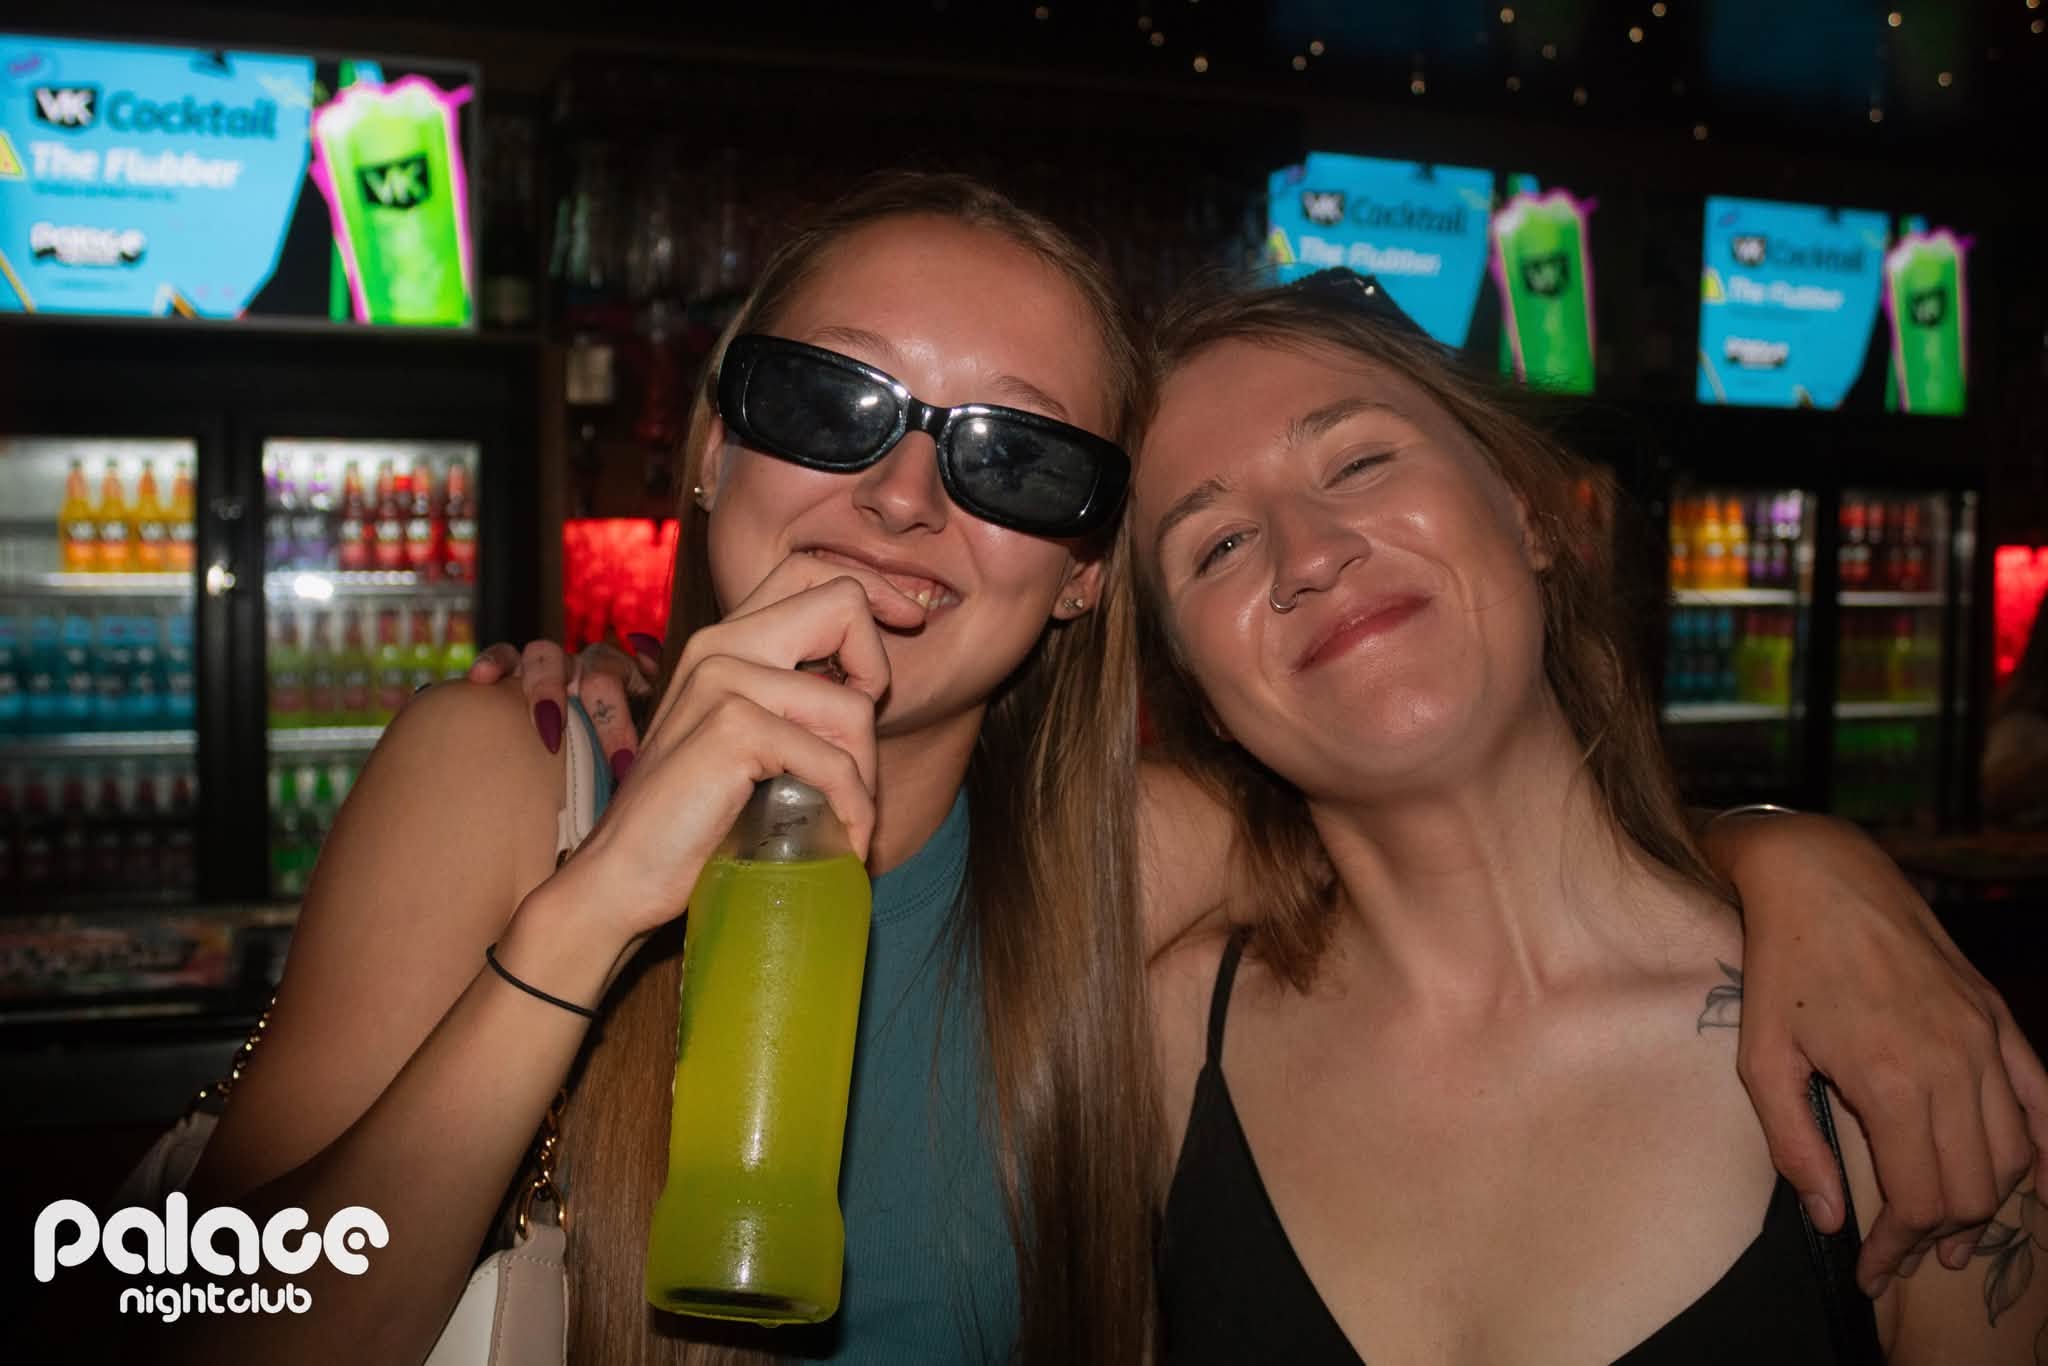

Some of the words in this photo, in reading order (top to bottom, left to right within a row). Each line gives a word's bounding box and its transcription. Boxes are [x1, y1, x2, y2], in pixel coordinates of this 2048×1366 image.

[36, 88, 95, 127] VK
[106, 90, 277, 139] Cocktail
[30, 141, 98, 181] The
[104, 147, 242, 189] Flubber
[364, 163, 427, 204] VK
